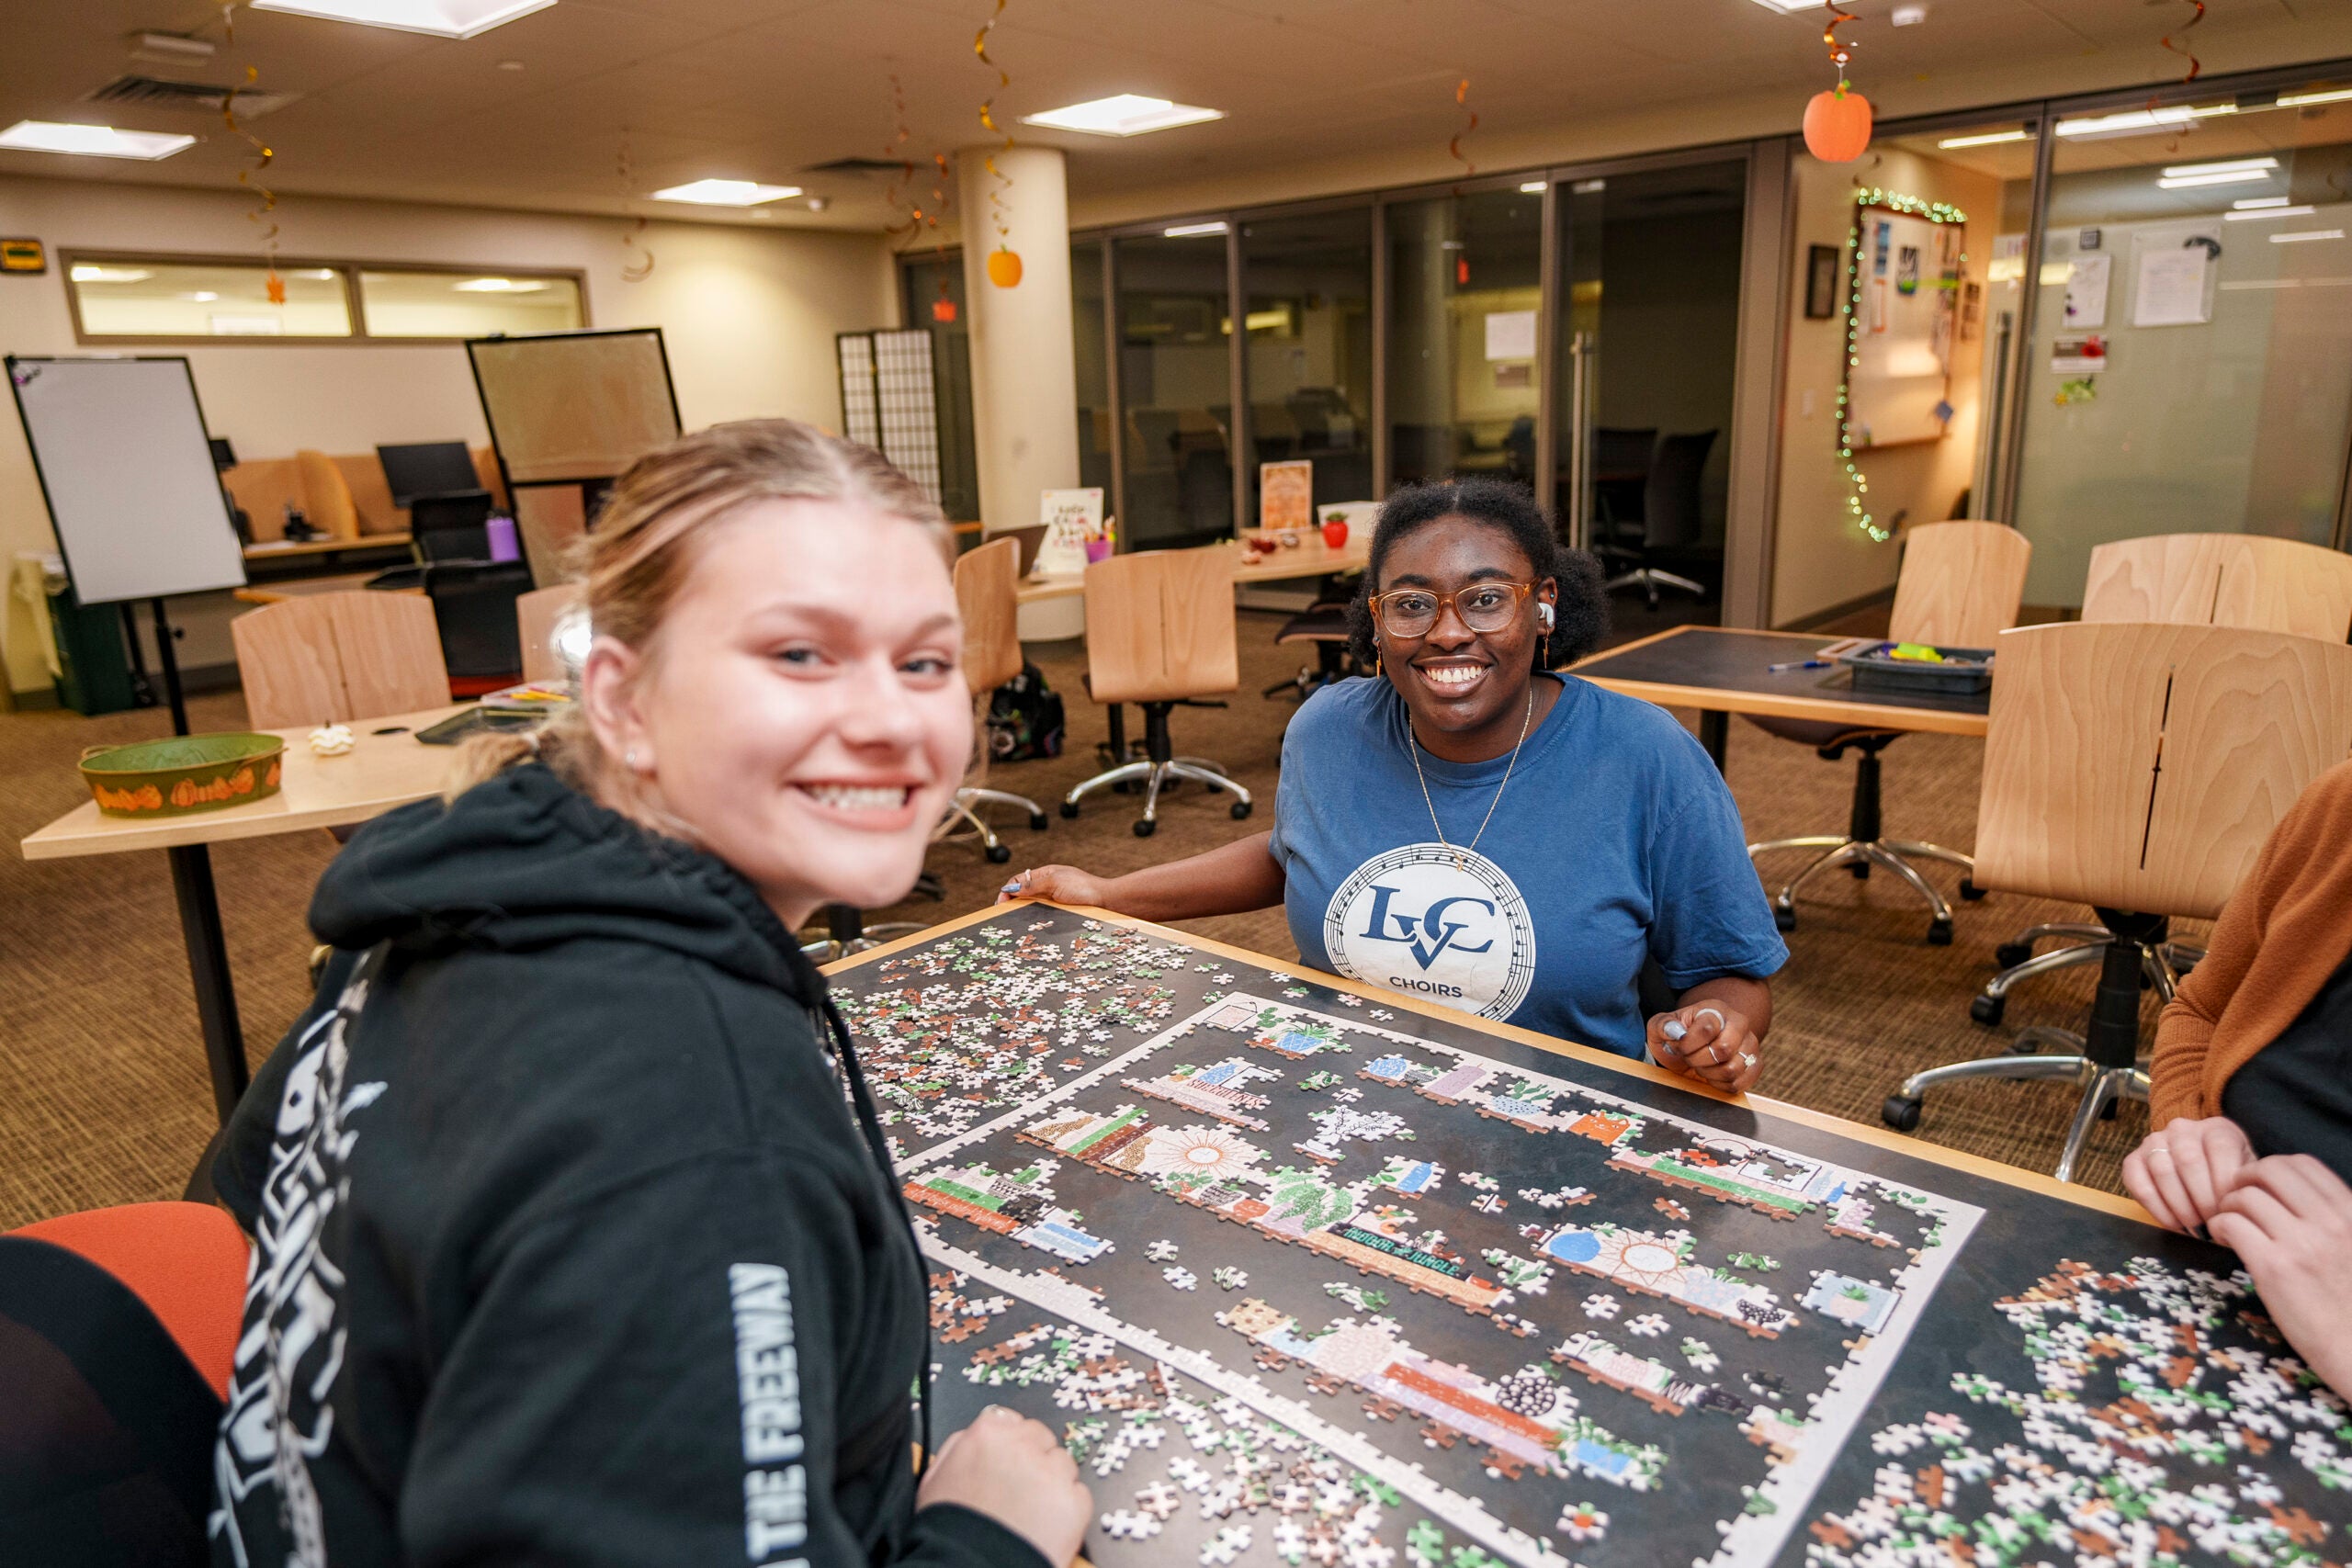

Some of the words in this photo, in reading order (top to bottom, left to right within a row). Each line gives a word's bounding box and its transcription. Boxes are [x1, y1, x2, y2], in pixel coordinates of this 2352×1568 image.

[1389, 976, 1463, 998] CHOIRS
[1343, 1225, 1396, 1252] INDOOR
[1406, 1250, 1460, 1276] JUNGLE
[728, 1262, 805, 1464] FREEWAY
[744, 1464, 808, 1561] THE
